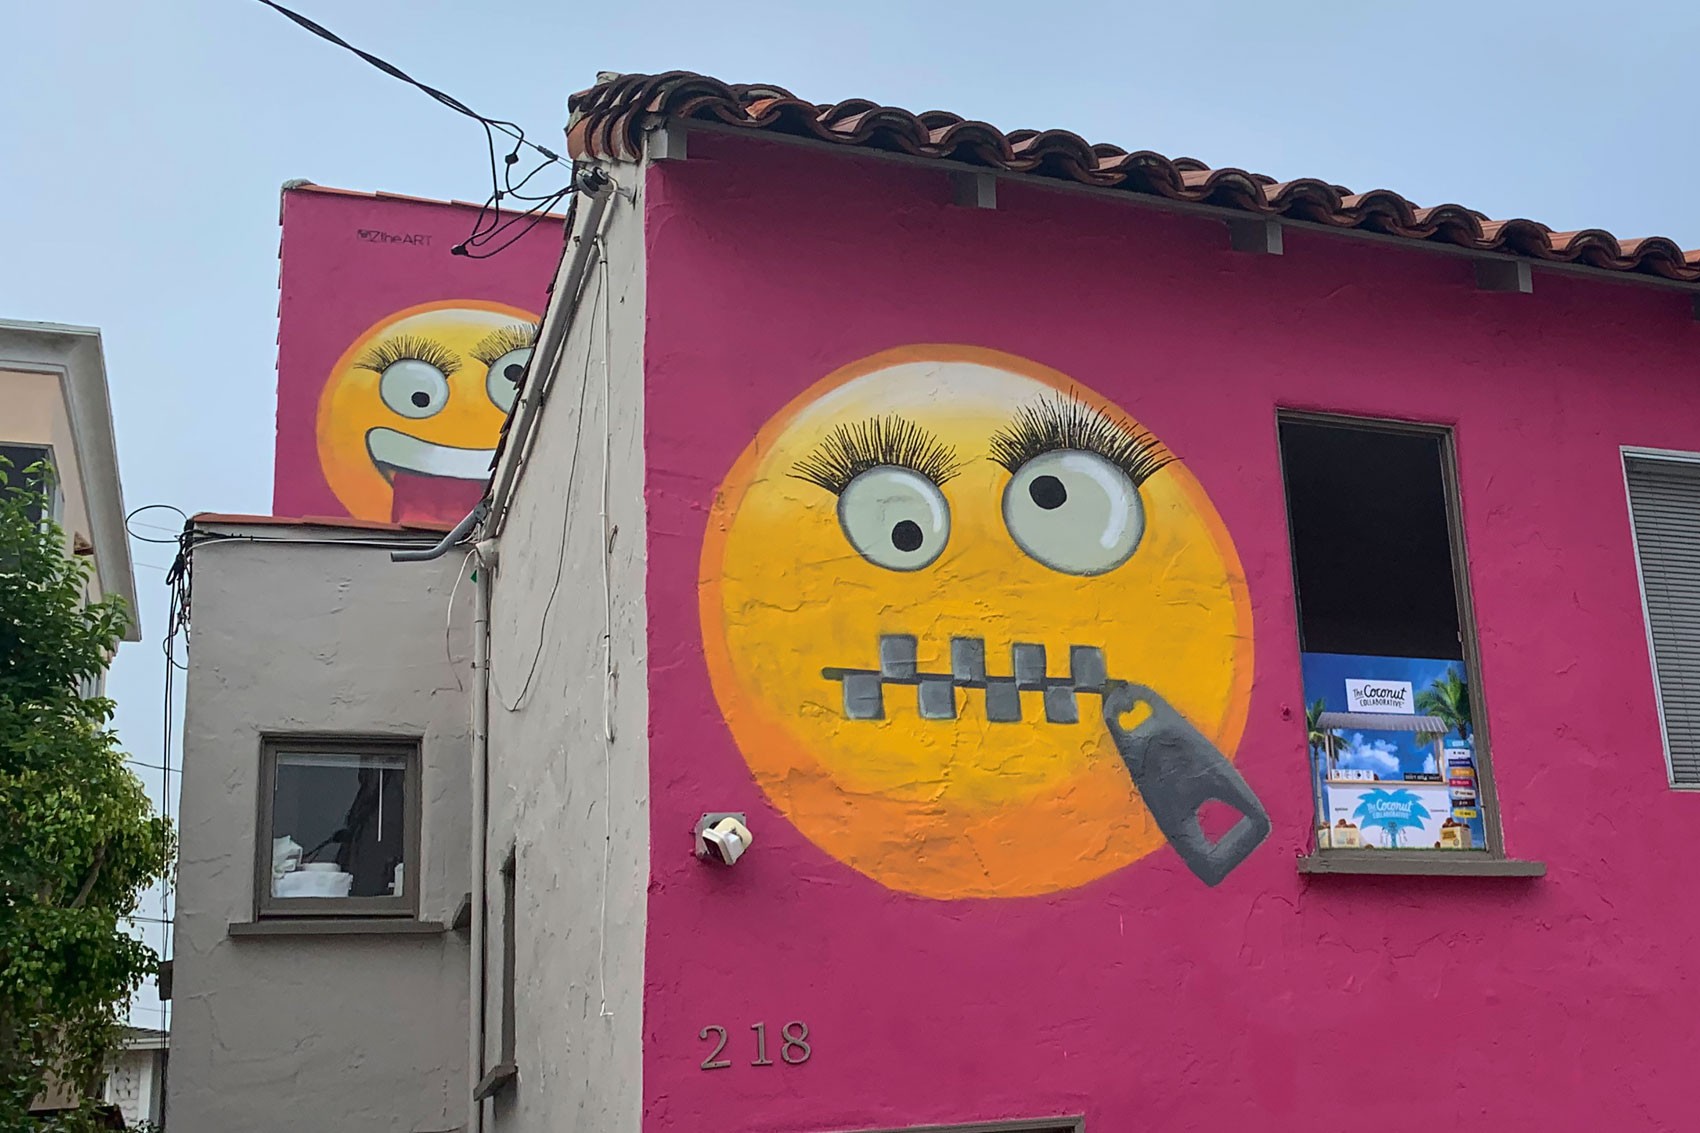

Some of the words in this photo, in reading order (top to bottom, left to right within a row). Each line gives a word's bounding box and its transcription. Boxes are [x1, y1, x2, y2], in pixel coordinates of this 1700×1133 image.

[1364, 684, 1407, 700] Coconut
[1376, 799, 1413, 812] Coconut
[699, 1021, 811, 1070] 218
